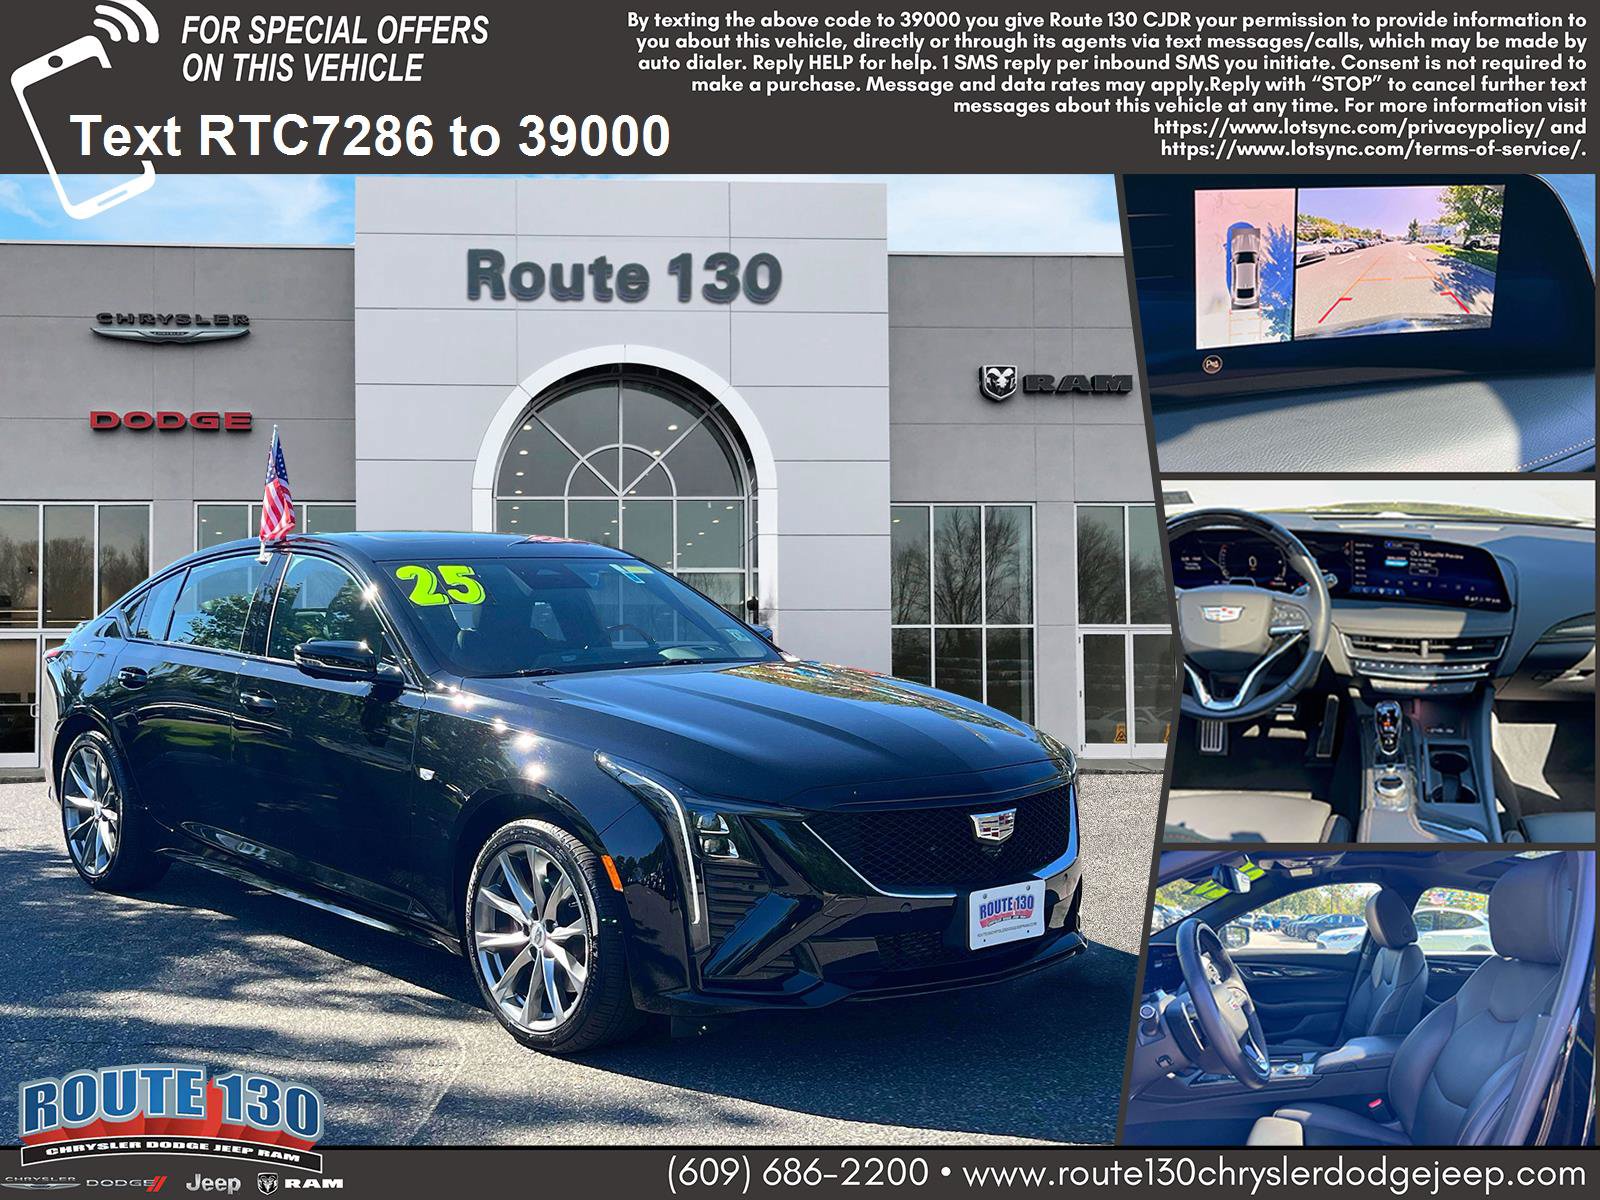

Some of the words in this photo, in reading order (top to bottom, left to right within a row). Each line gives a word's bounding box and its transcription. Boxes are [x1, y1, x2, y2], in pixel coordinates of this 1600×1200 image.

[467, 248, 649, 302] Route
[668, 252, 782, 304] 130
[96, 312, 250, 326] CHRYSLER
[1023, 374, 1133, 394] RAM
[90, 410, 253, 431] DODGE
[395, 563, 487, 607] 25
[979, 897, 1013, 919] ROUTE
[1015, 895, 1034, 909] 130
